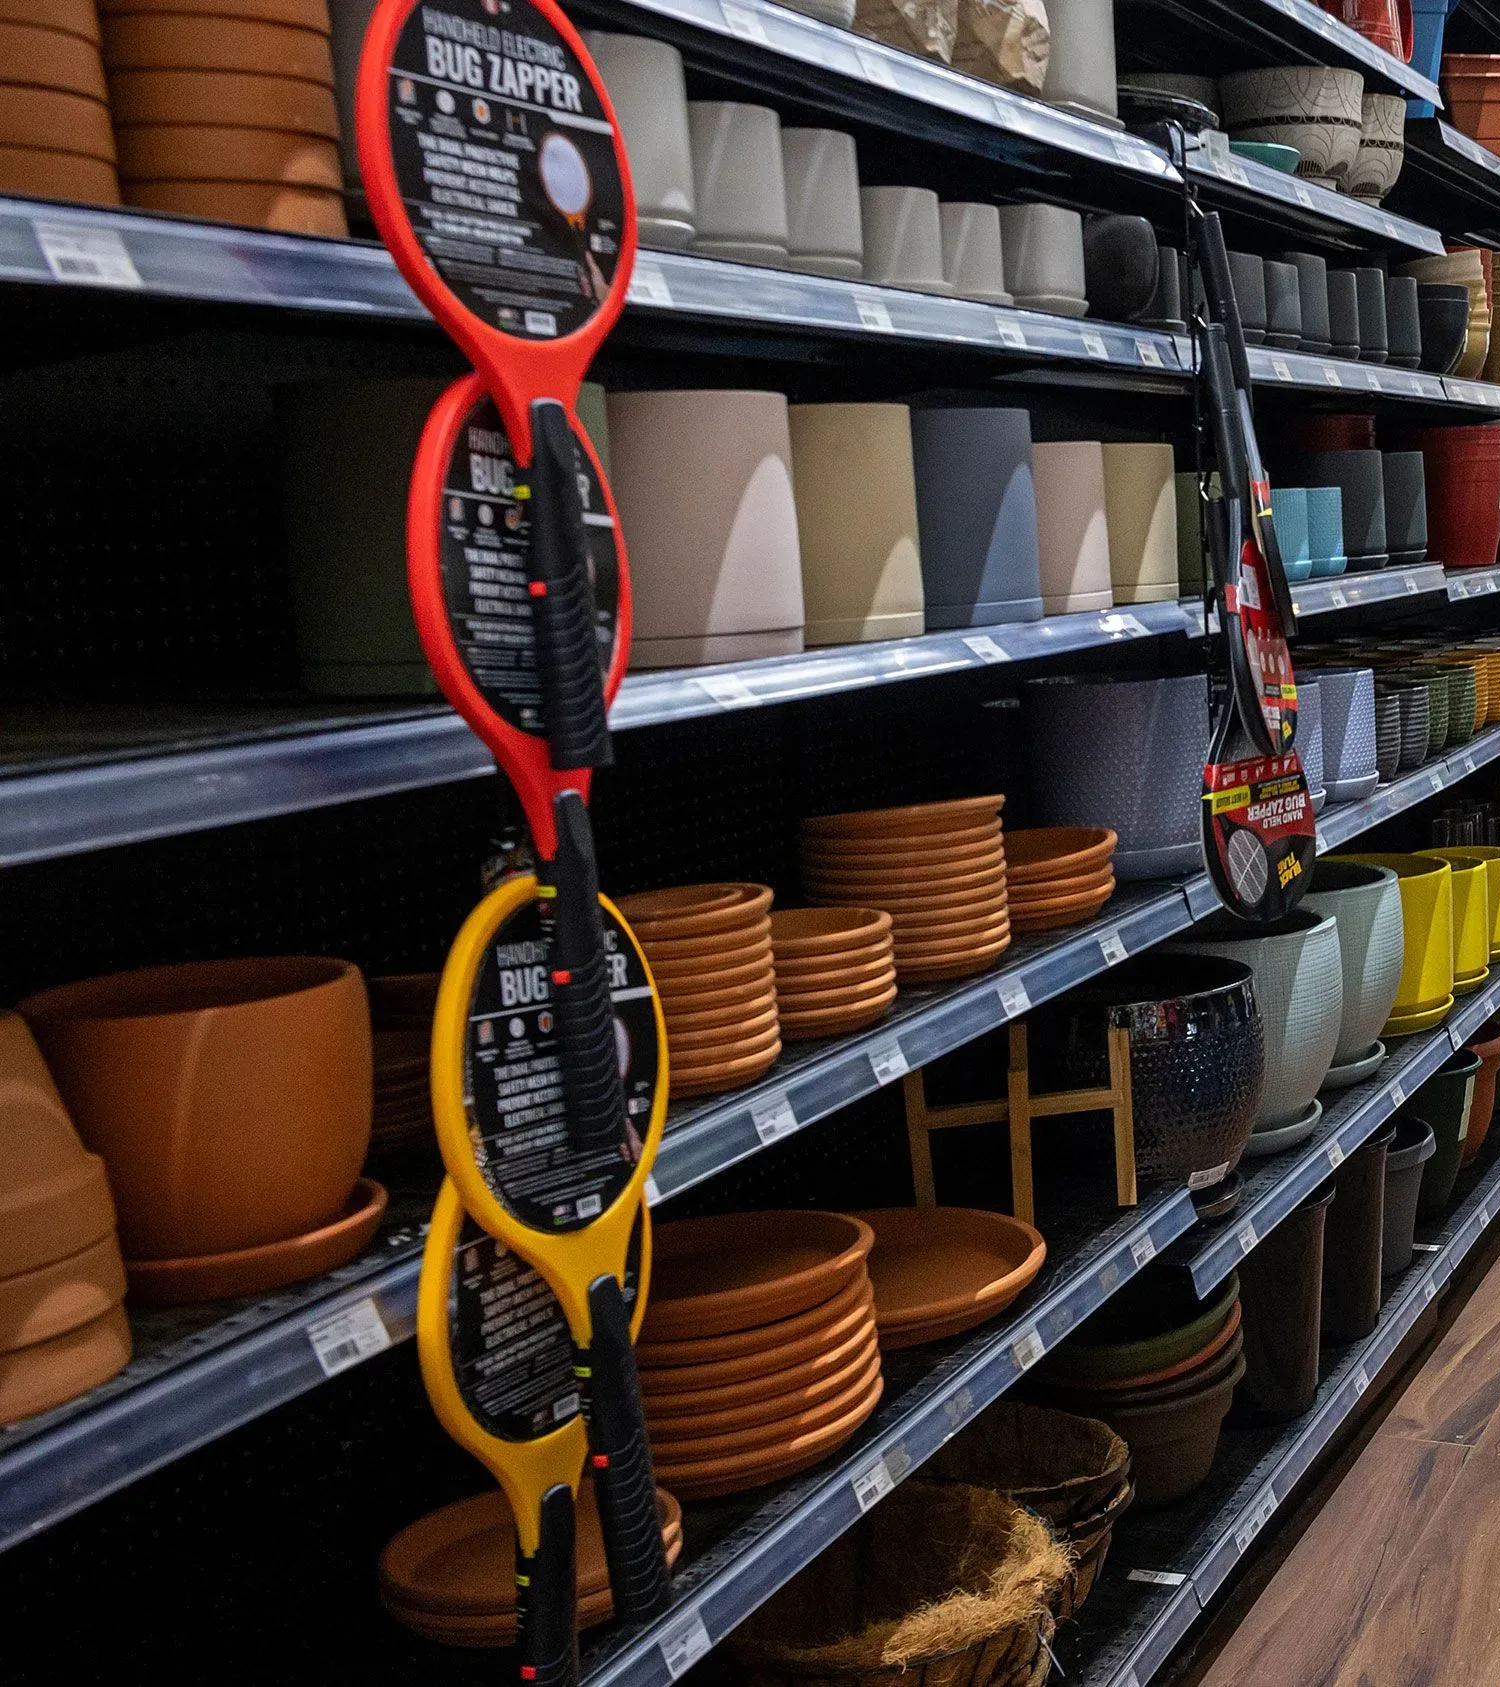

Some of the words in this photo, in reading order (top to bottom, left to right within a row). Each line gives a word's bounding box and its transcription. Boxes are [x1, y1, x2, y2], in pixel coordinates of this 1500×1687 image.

[502, 28, 566, 71] ELECTRIC
[425, 34, 484, 88] BUG
[487, 52, 583, 113] ZAPPER
[470, 453, 514, 495] BUG
[1248, 798, 1284, 821] ZAPPER
[1285, 793, 1306, 810] BUG
[1263, 814, 1282, 829] HELD
[1282, 809, 1303, 824] HAND
[1277, 852, 1296, 875] FLAG
[1280, 860, 1302, 889] BLACK
[500, 965, 549, 1007] BUG
